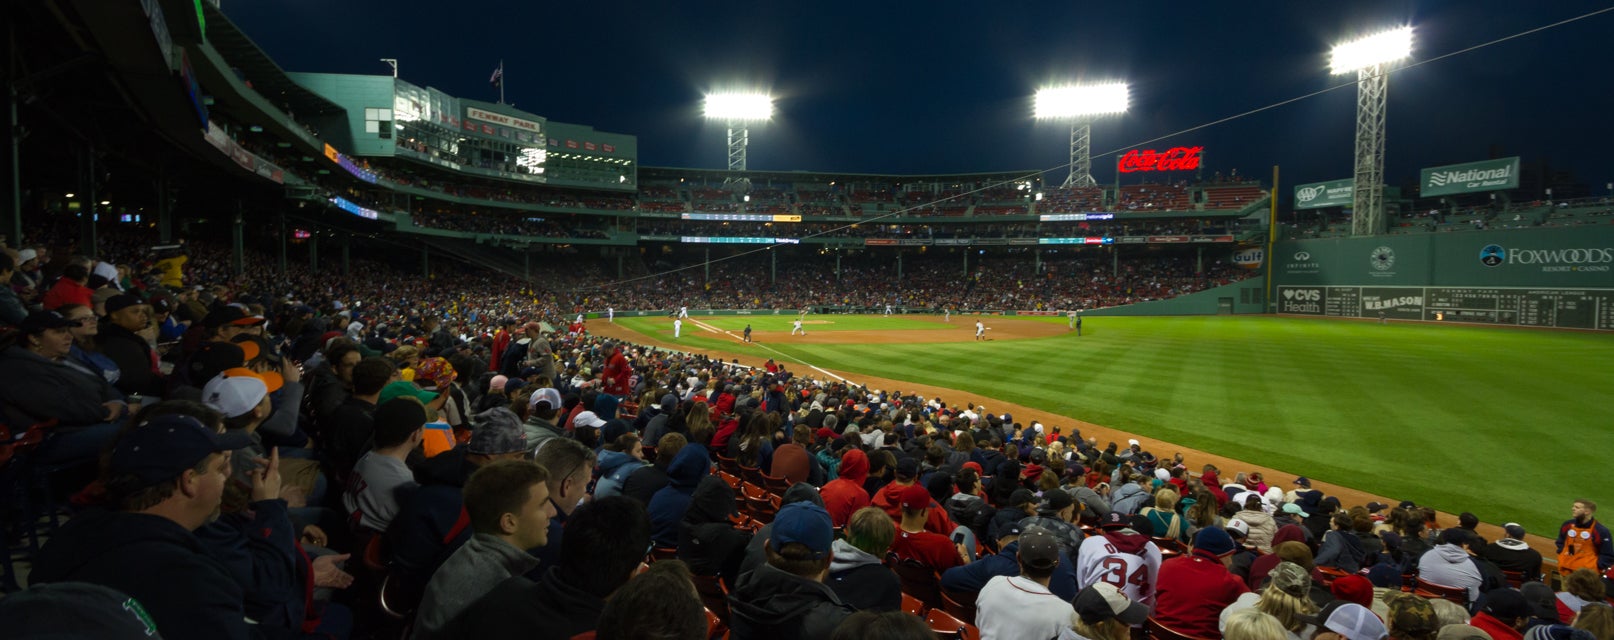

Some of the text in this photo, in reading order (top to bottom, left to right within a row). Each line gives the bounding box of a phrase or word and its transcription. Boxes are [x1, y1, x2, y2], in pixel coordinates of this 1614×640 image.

[472, 110, 537, 130] FENWAY PARK
[1118, 146, 1204, 173] Coca-Cola
[1446, 165, 1511, 184] National
[1233, 251, 1262, 263] Gulf
[1508, 247, 1613, 264] FOXWOODS
[1295, 289, 1321, 301] CVS
[1284, 301, 1321, 312] Health
[1101, 557, 1149, 596] 34
